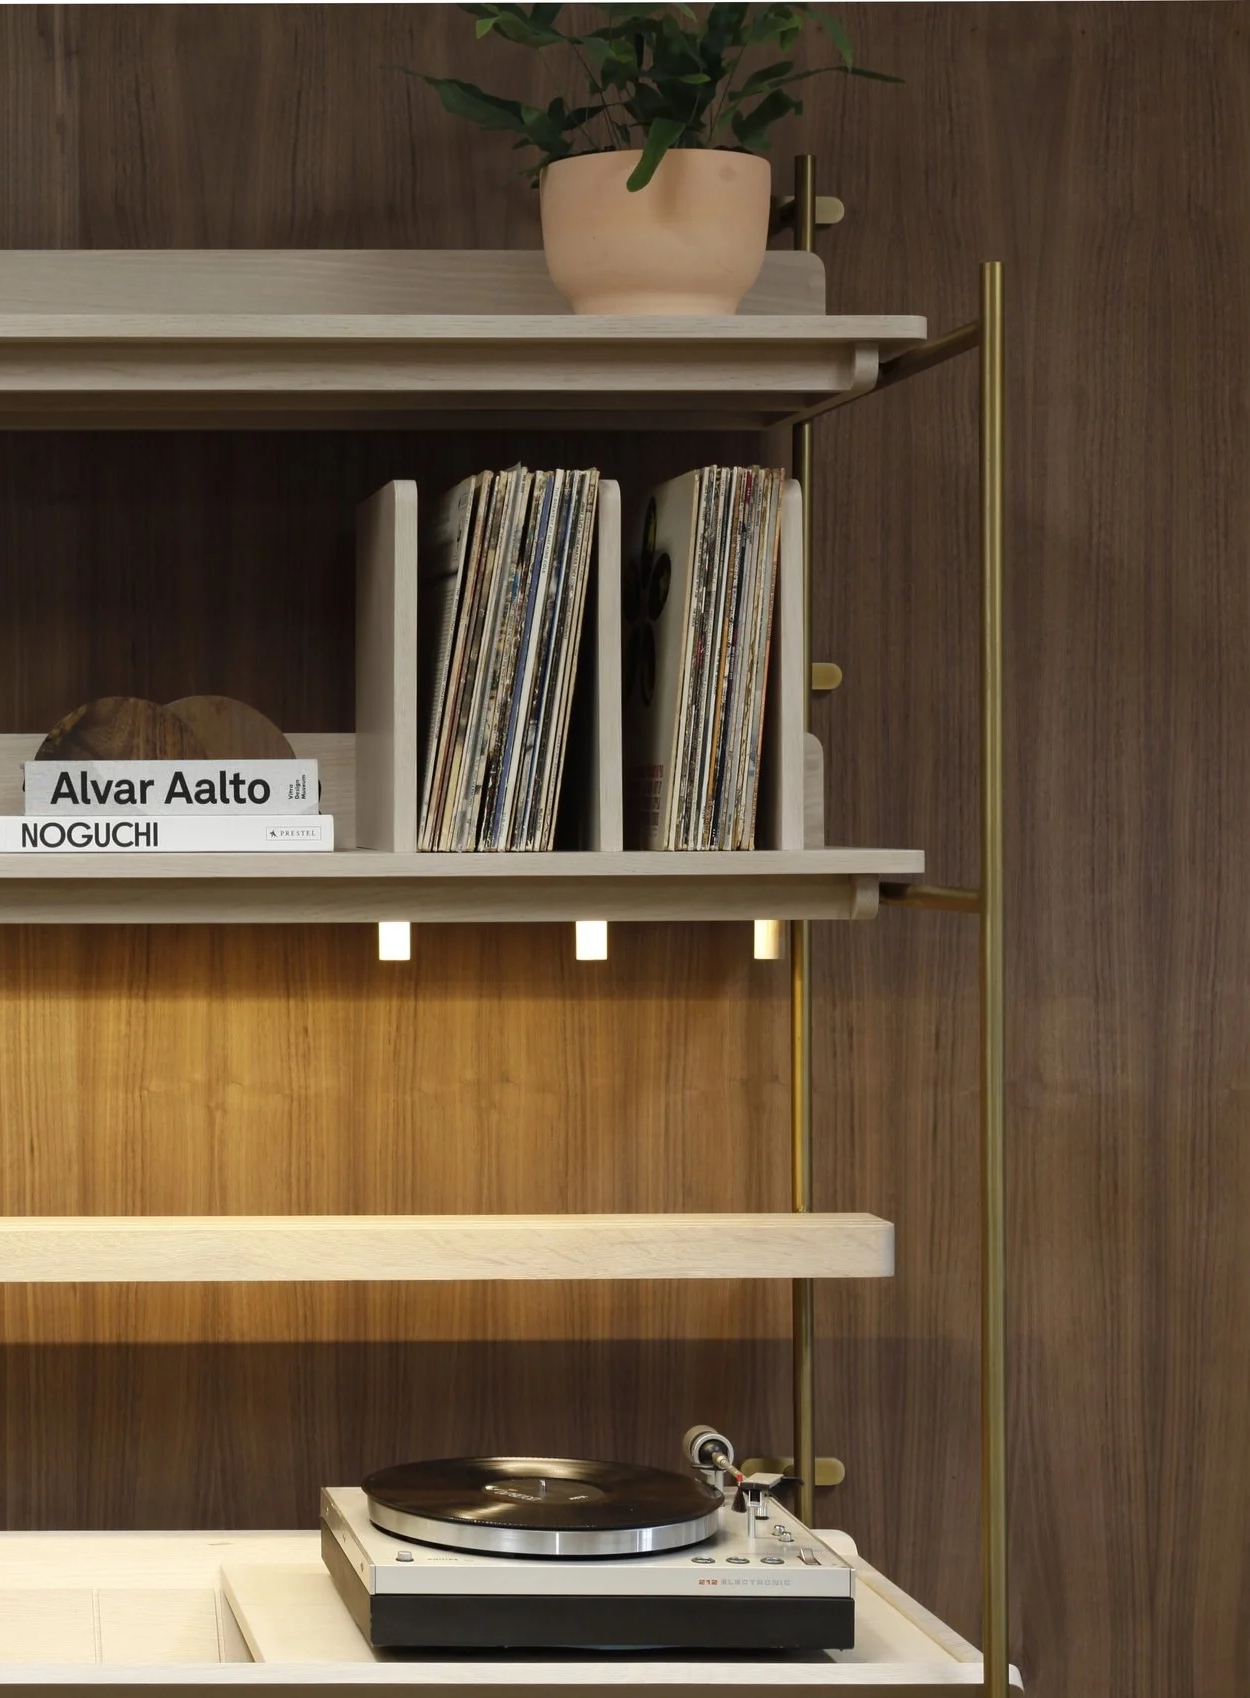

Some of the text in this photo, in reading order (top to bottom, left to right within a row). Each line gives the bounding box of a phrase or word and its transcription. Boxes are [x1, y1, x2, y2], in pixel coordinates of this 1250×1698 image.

[50, 770, 271, 805] Alvar Aalto
[22, 822, 158, 848] NOGUCHI
